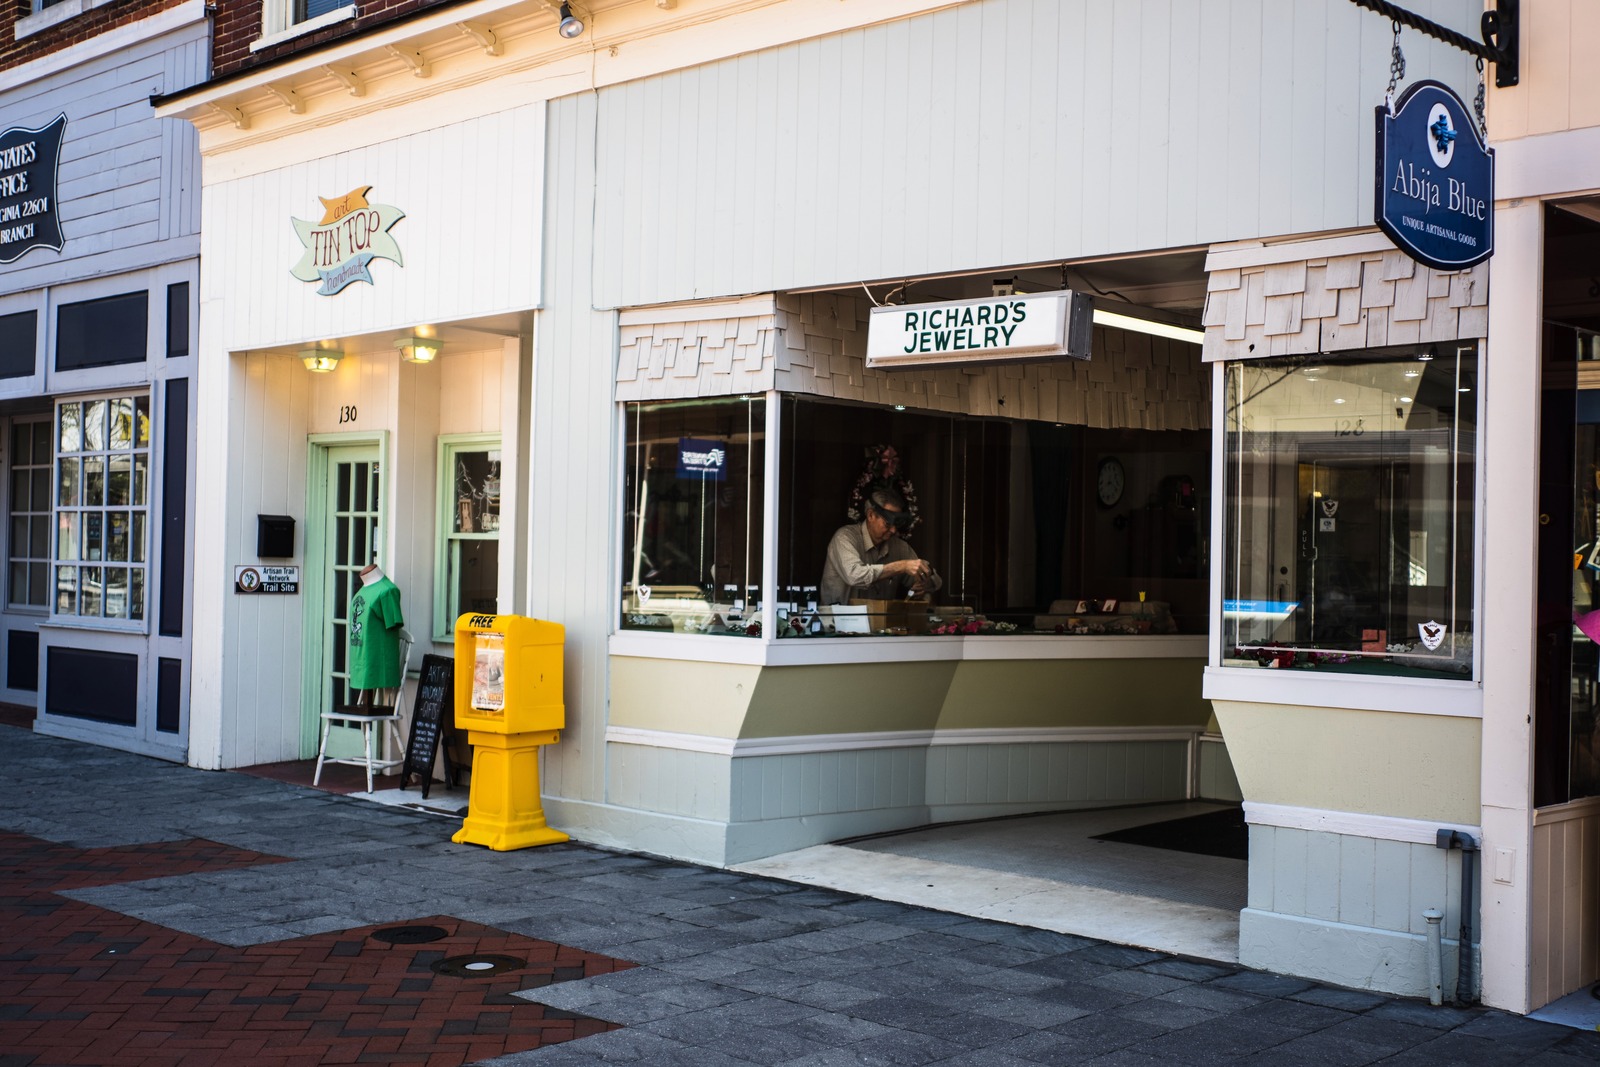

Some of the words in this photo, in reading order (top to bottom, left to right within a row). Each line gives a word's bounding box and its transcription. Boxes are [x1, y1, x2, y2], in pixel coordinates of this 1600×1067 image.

[0, 171, 28, 198] FICE
[1392, 159, 1441, 215] Abija
[1448, 178, 1486, 221] Blue
[22, 197, 47, 217] 22601
[334, 196, 351, 219] art
[0, 223, 35, 245] BRANCH
[310, 226, 341, 266] TIN
[343, 210, 380, 255] TOP
[1402, 215, 1425, 231] UNIQUE
[1425, 223, 1457, 241] ARTISANAL
[1458, 232, 1477, 247] GOODS
[326, 258, 365, 291] handmade
[905, 302, 1026, 331] RICHARD'S
[904, 324, 1017, 353] JEWELRY
[339, 405, 357, 424] 130
[1334, 419, 1366, 437] 128
[263, 583, 279, 592] Trail
[280, 583, 295, 592] Site
[469, 615, 497, 628] FREE
